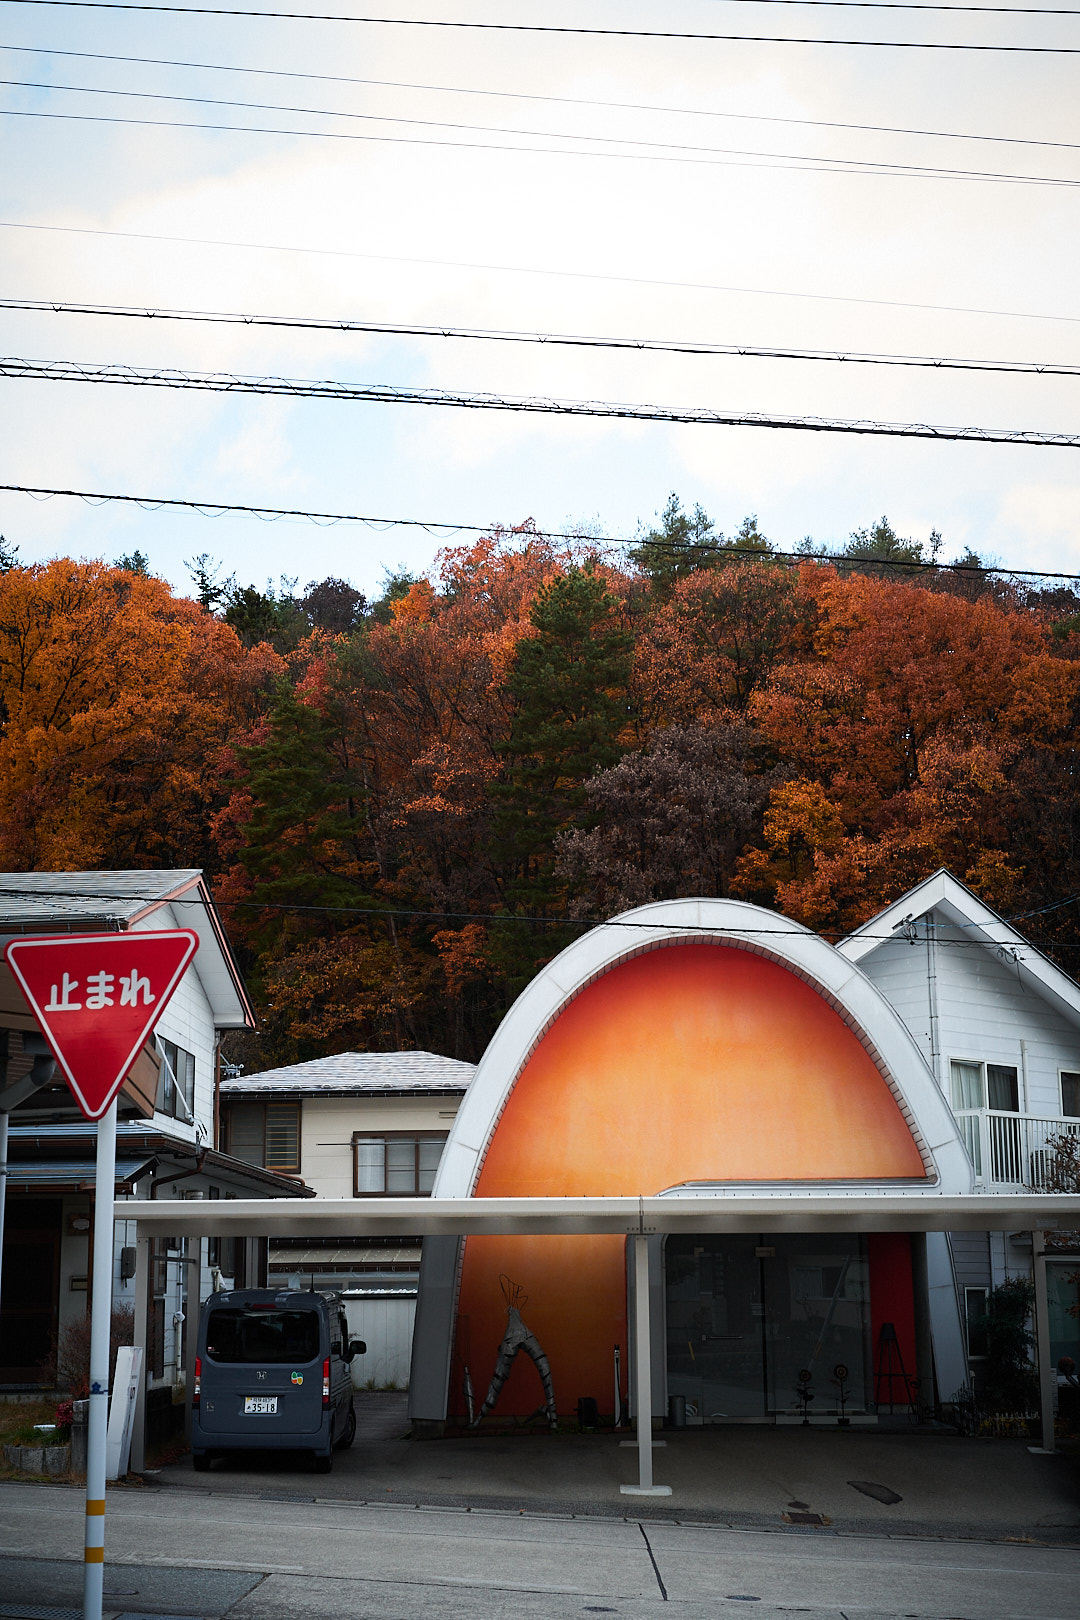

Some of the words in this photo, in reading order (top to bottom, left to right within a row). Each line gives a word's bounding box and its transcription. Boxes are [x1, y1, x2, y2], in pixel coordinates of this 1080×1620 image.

[44, 969, 156, 1012] 止まれ
[252, 1403, 275, 1413] 35-18
